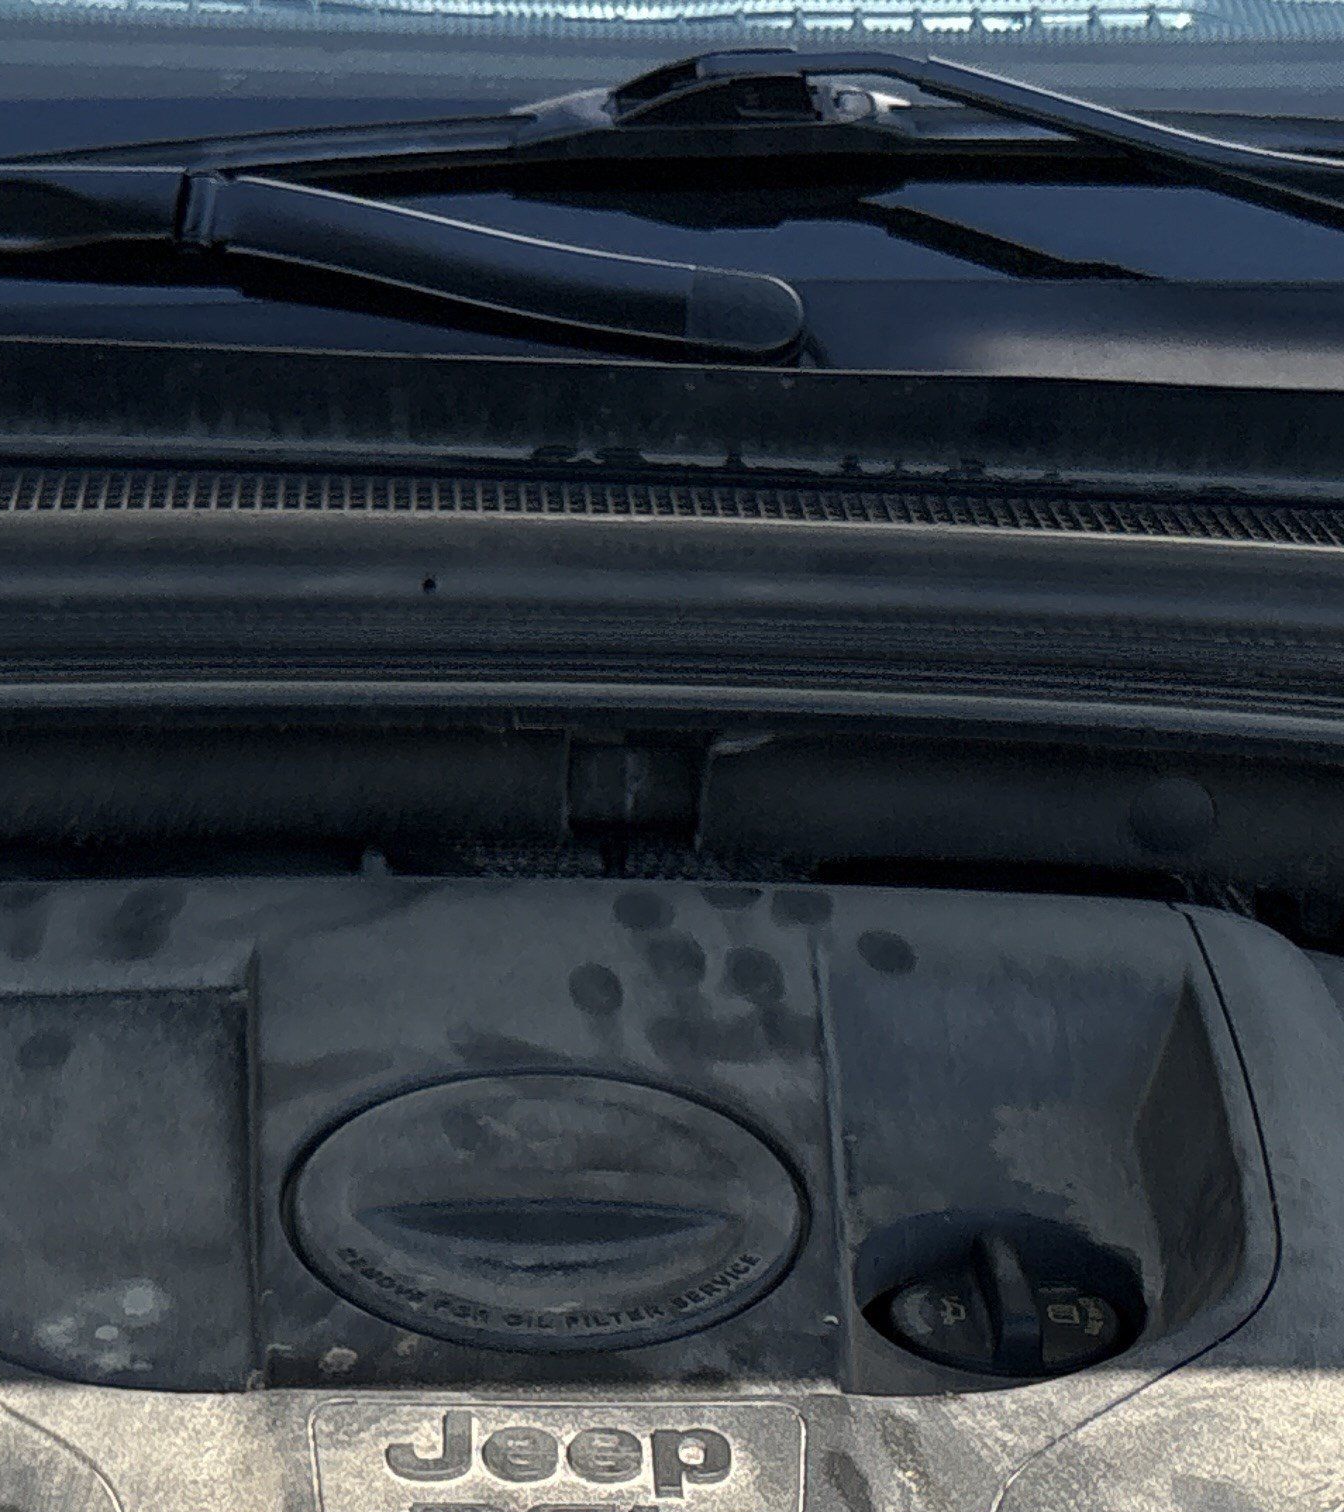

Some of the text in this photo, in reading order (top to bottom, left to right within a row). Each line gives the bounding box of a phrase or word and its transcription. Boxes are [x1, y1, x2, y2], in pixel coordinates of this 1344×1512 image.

[504, 1312, 555, 1330] OIL
[565, 1302, 665, 1329] FILTER
[669, 1254, 762, 1310] SERVICE
[385, 1410, 733, 1500] Jeep
